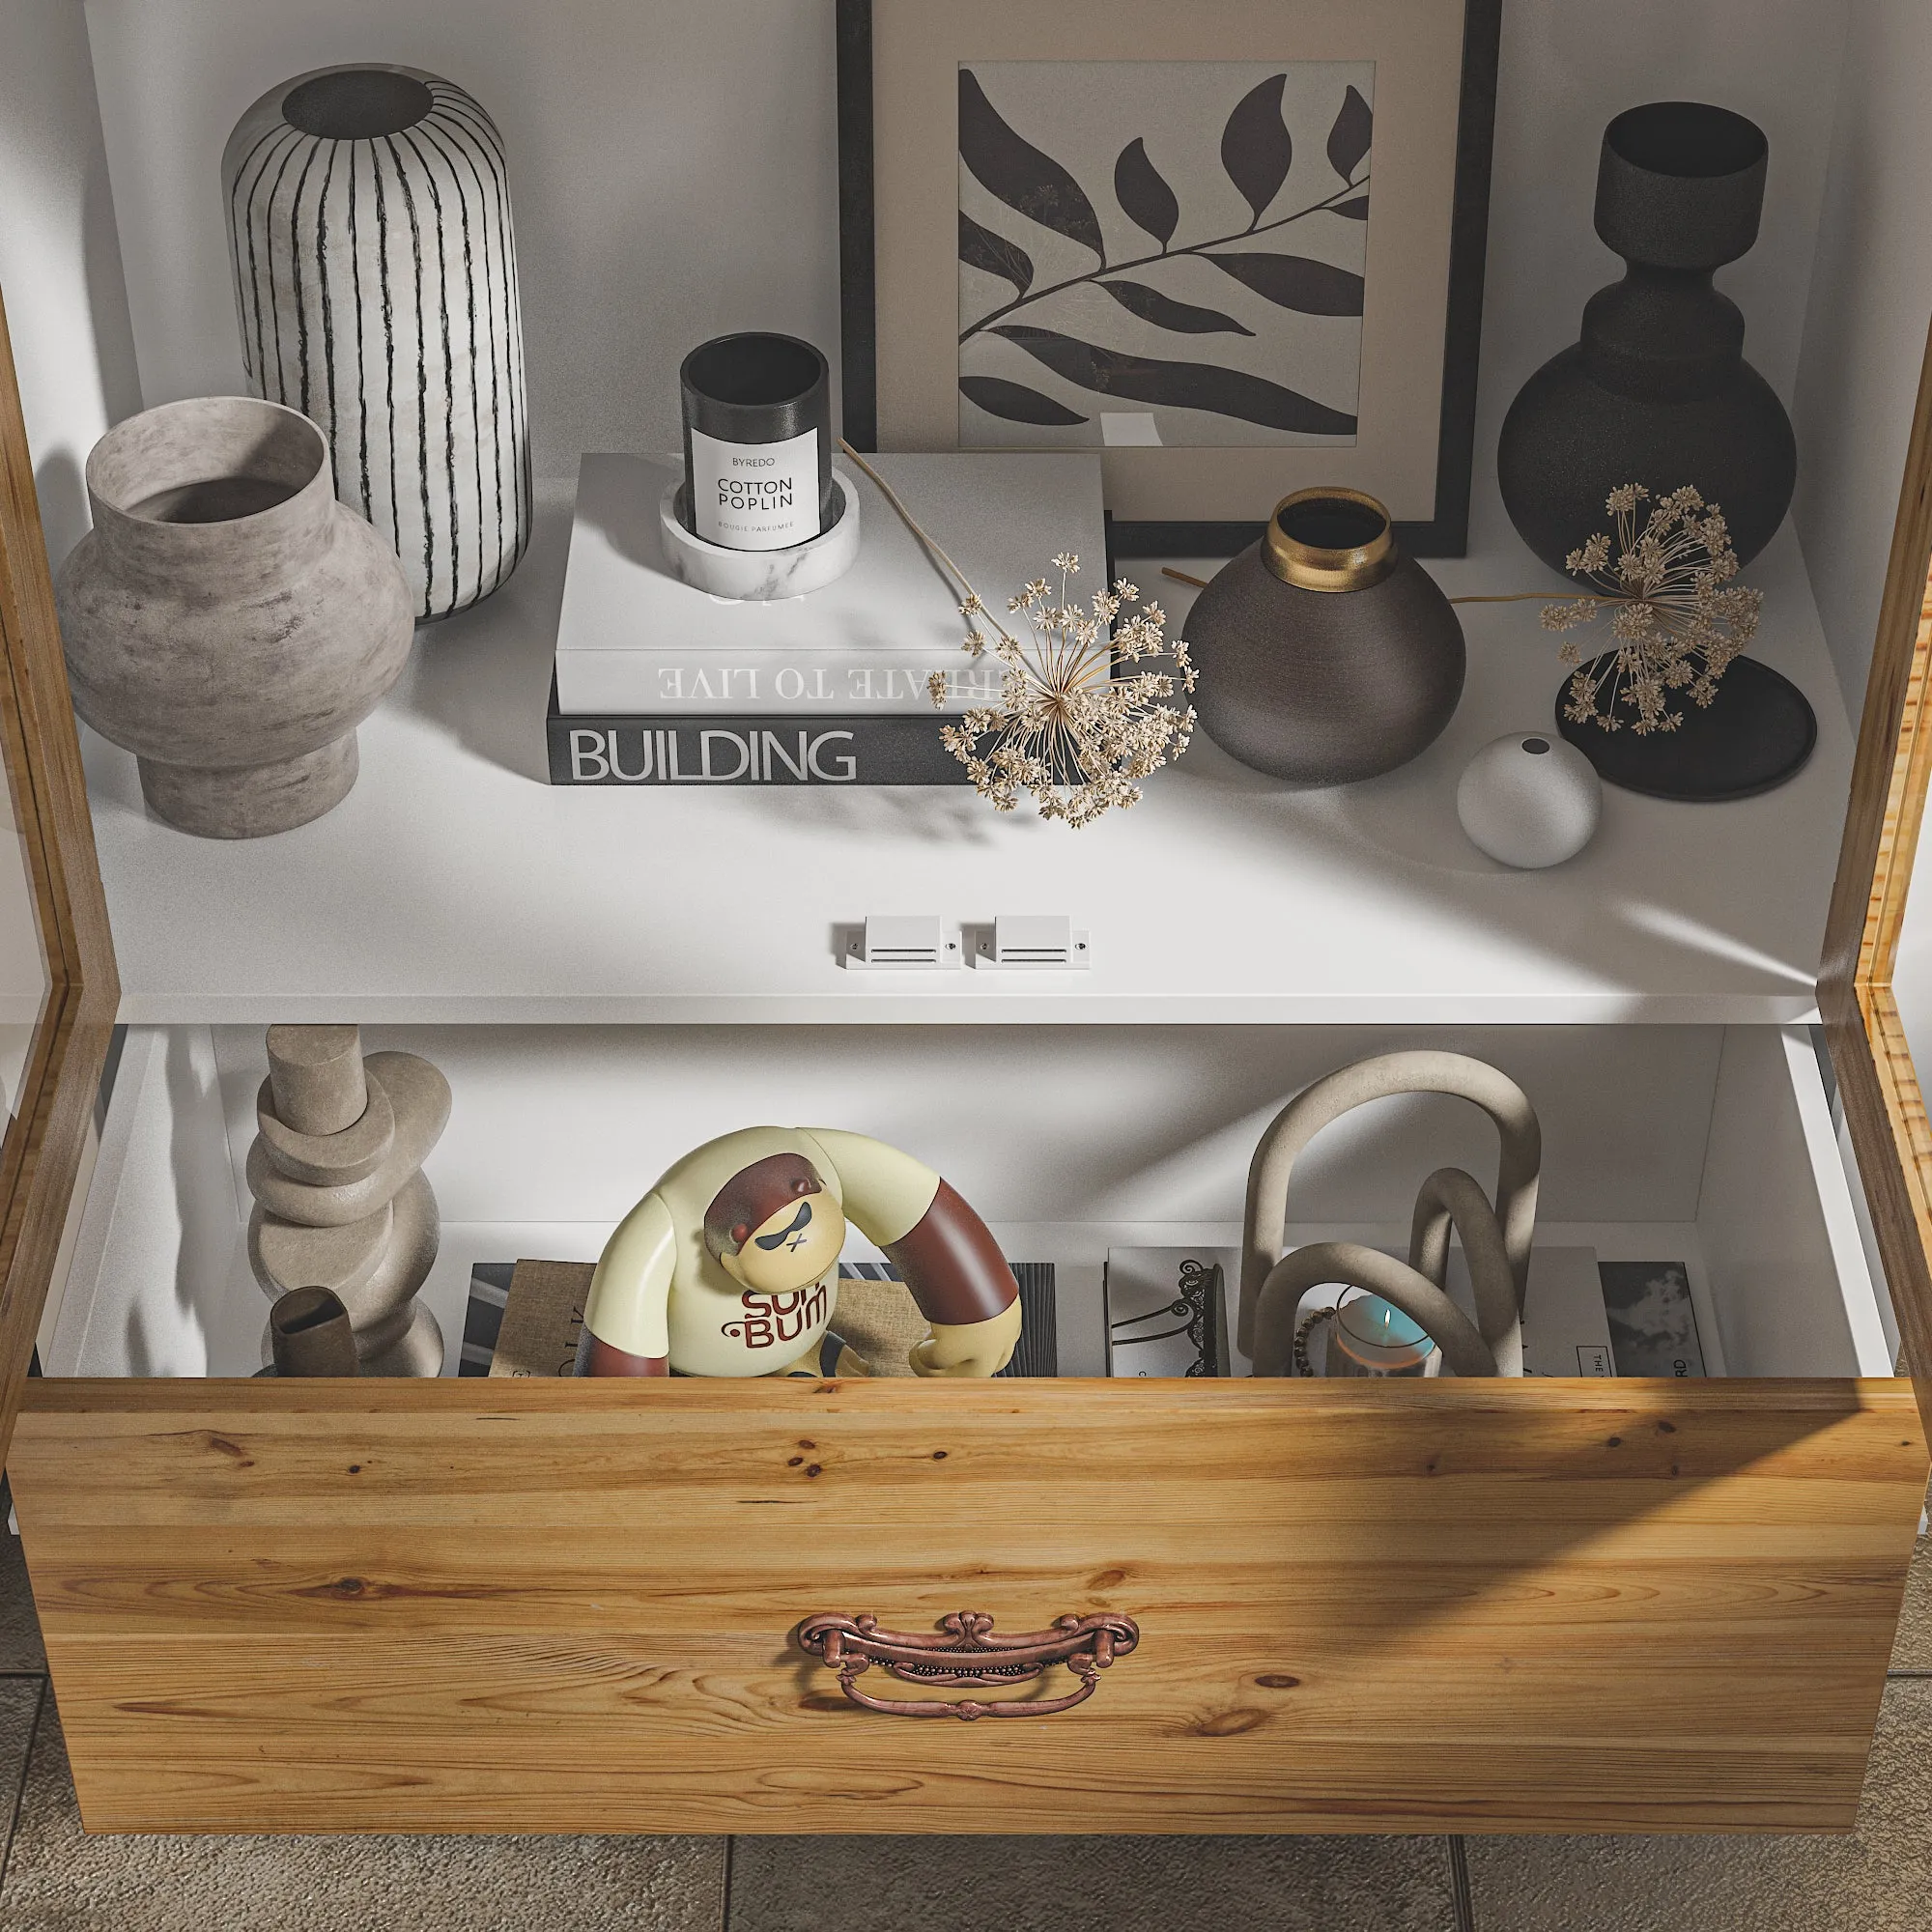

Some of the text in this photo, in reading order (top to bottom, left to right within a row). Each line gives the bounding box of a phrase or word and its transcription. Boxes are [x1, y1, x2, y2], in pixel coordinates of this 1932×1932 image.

[732, 457, 775, 468] BYREDO
[718, 477, 792, 495] COTTON
[719, 493, 792, 510] POPLIN
[718, 521, 749, 532] BOUGIE
[658, 668, 1012, 700] REATE TO LIVE
[570, 729, 857, 781] BUILDING
[1593, 1354, 1604, 1372] THE
